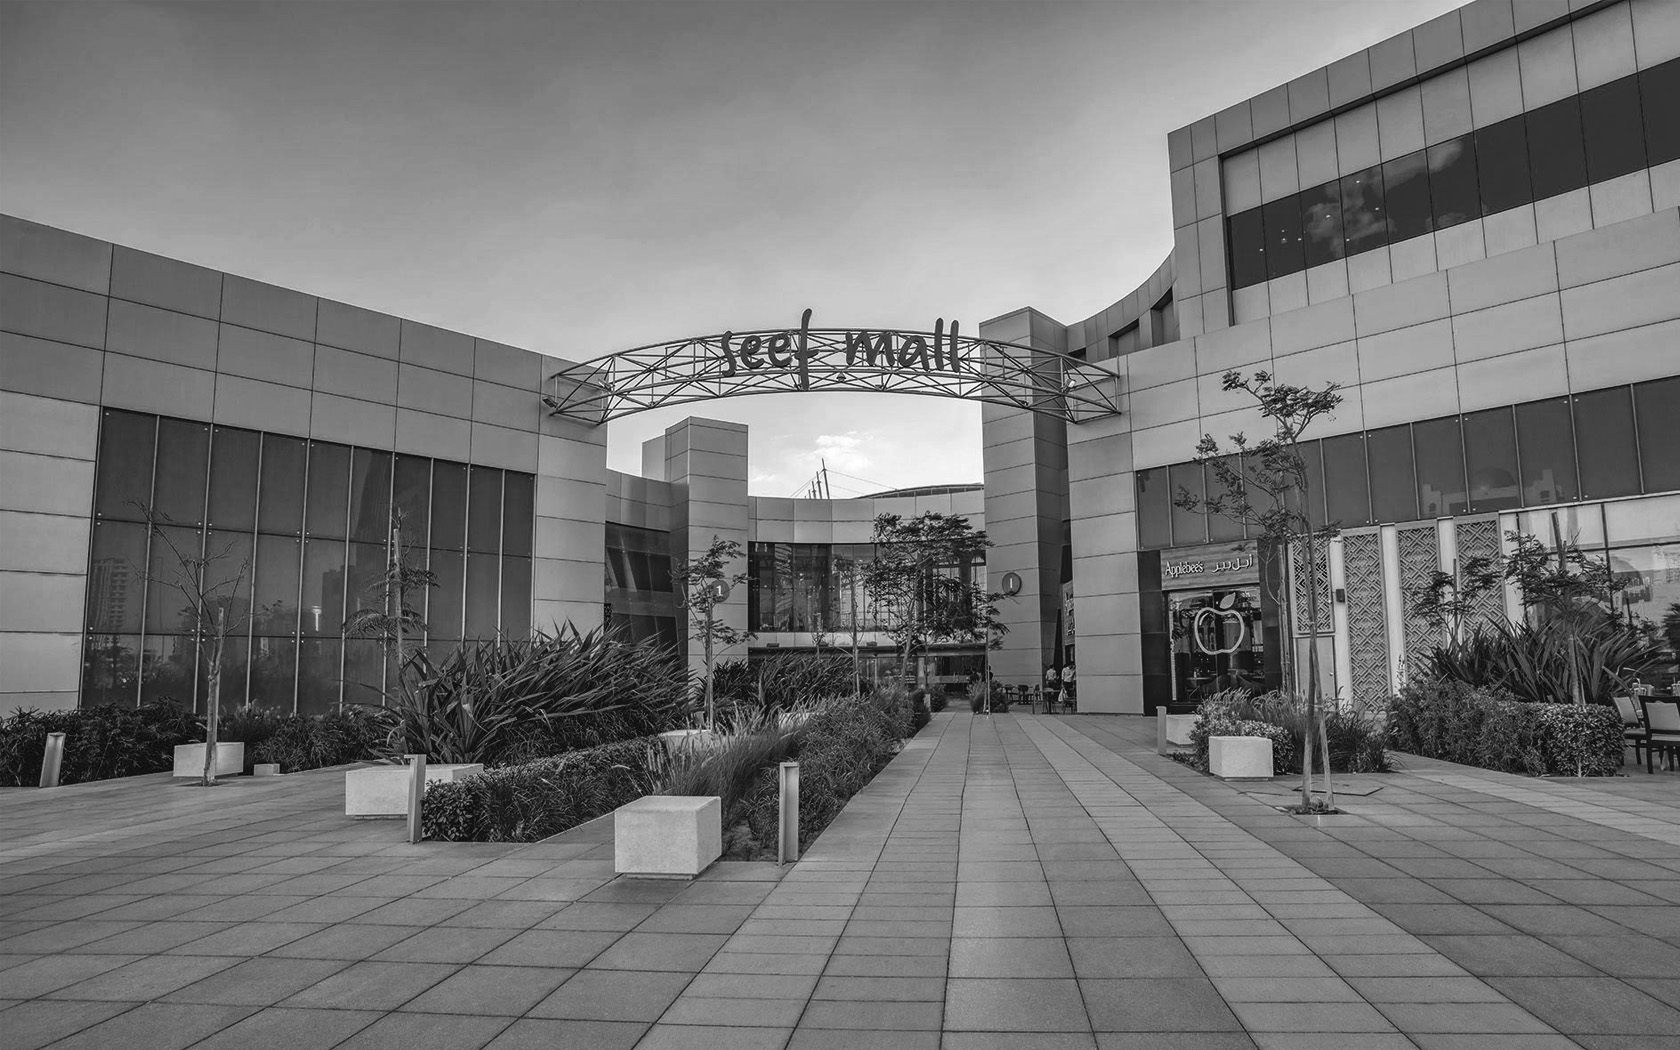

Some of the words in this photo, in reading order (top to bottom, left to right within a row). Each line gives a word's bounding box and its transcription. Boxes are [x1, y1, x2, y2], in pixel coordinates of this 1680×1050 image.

[721, 308, 819, 392] seef
[845, 317, 961, 374] mall
[1165, 561, 1204, 578] Applebee's
[716, 585, 723, 597] 1
